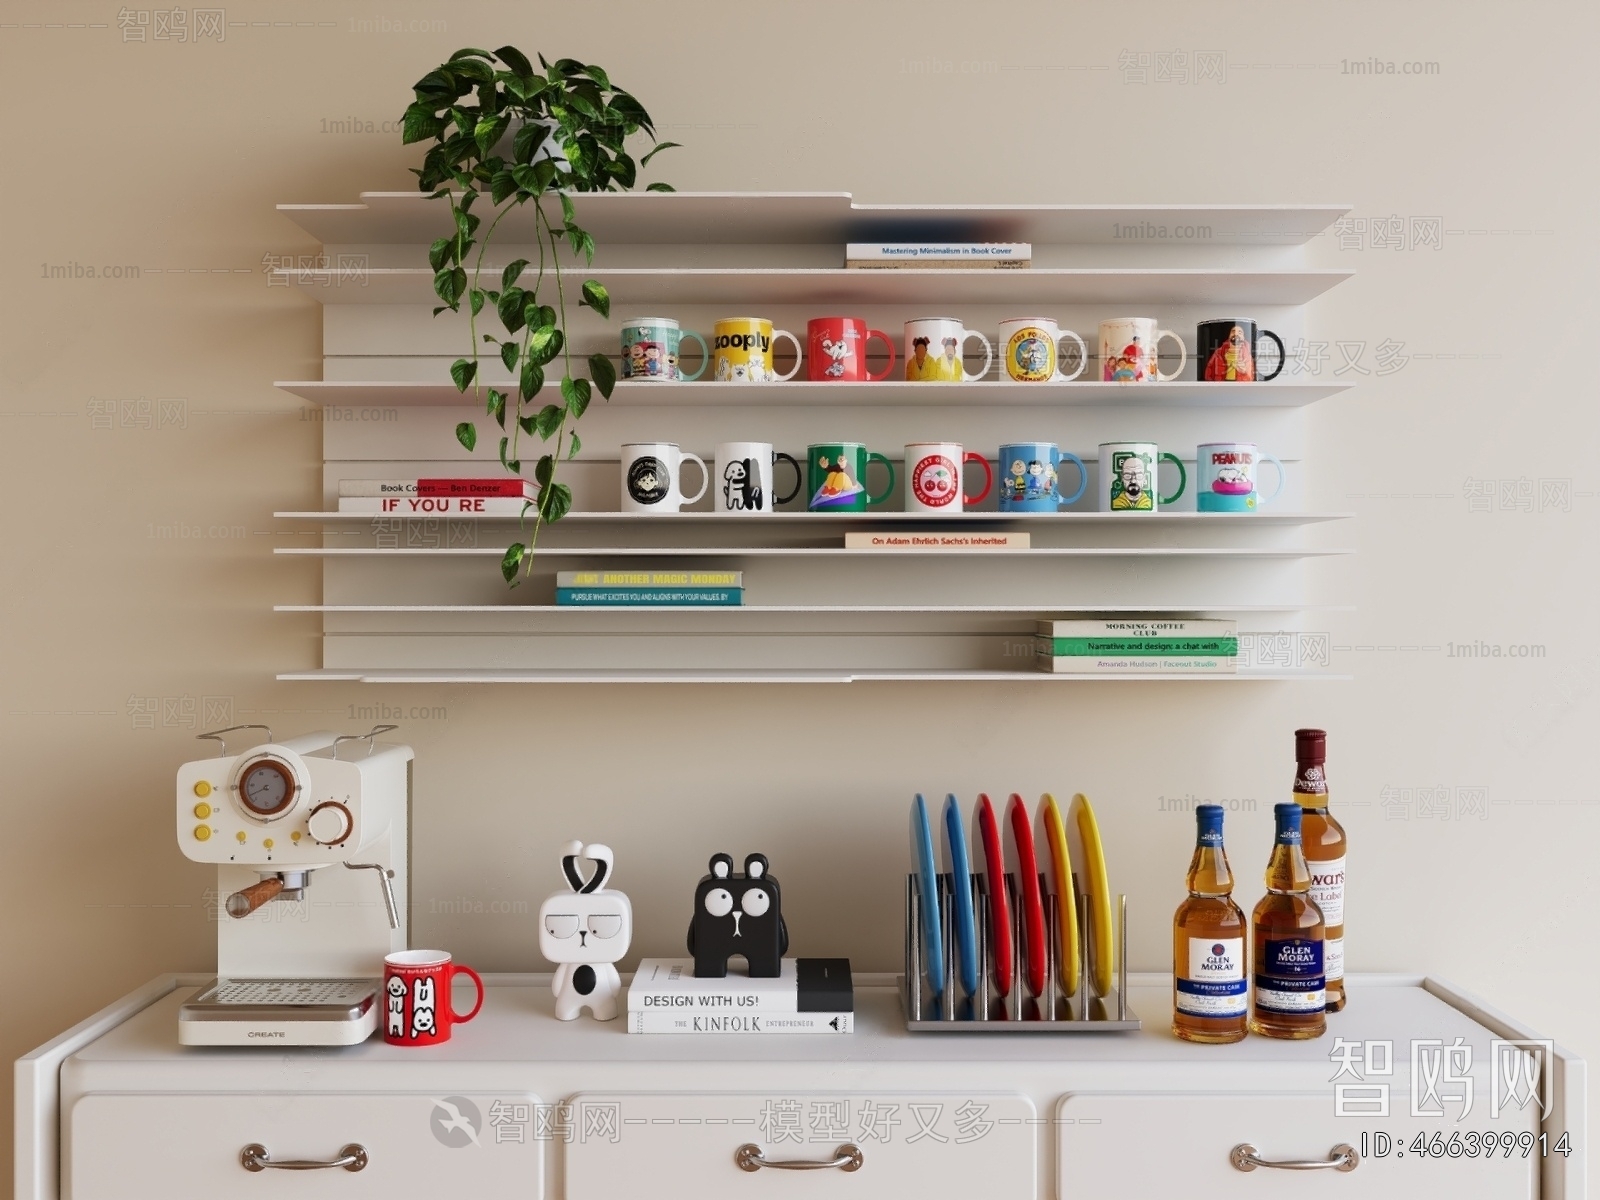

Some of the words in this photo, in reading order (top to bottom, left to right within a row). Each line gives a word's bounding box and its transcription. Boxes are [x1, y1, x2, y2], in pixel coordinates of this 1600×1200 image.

[882, 247, 918, 256] Mastering
[919, 247, 961, 255] Minimalism
[962, 247, 969, 255] in
[971, 247, 989, 255] Book
[991, 247, 1012, 255] Cover
[1211, 453, 1253, 465] PEANUTS
[381, 484, 403, 493] Book
[406, 484, 436, 492] Covers
[451, 484, 470, 492] Ben
[472, 484, 501, 492] Denzer
[382, 499, 400, 512] IF
[408, 499, 449, 512] YOU
[460, 499, 485, 512] RE
[872, 537, 883, 545] On
[886, 537, 910, 545] Adam
[912, 537, 939, 545] Ehrlich
[971, 537, 1007, 545] Inherited
[603, 574, 650, 584] ANOTHER
[653, 574, 688, 584] MAGIC
[690, 574, 736, 584] MONDAY
[571, 593, 593, 601] PURSUE
[593, 593, 608, 601] WHAT
[1088, 642, 1124, 650] Narrative
[1127, 642, 1142, 650] and
[1182, 642, 1200, 650] chat
[1202, 642, 1219, 650] with
[1097, 660, 1128, 668] Amanda
[1129, 660, 1157, 668] Hudson
[1164, 660, 1192, 668] Faceout
[1194, 660, 1217, 668] Studio
[1312, 871, 1344, 885] war's
[1282, 946, 1311, 954] GLEN
[1278, 953, 1315, 962] MORAY
[644, 995, 693, 1007] DESIGN
[698, 995, 732, 1006] WITH
[737, 995, 759, 1007] US!
[693, 1016, 761, 1032] KINFOLK
